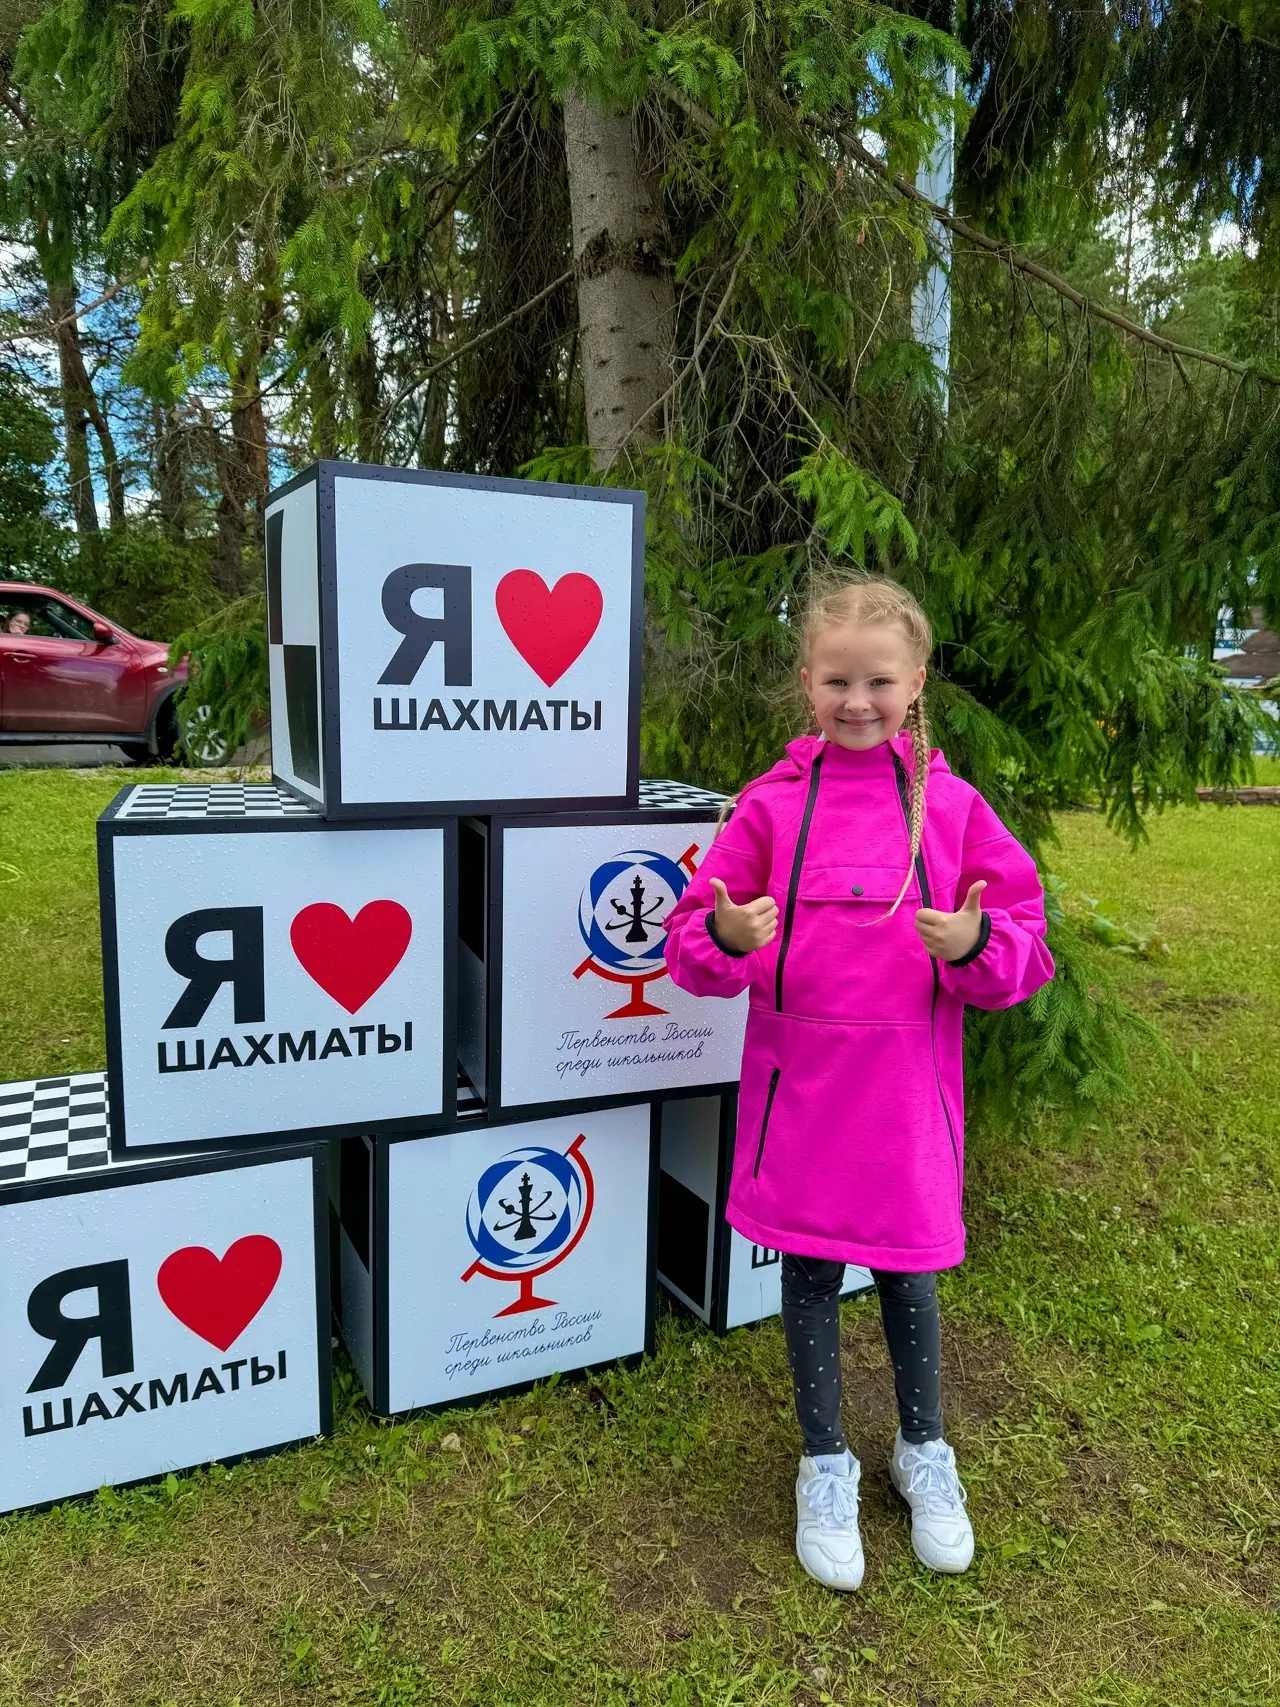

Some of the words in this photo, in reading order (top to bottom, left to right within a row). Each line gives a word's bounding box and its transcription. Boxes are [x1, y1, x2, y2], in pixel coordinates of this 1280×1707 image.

[377, 564, 472, 686] Я
[374, 698, 601, 730] ШАХМАТЫ
[161, 906, 265, 1029] Я
[158, 1022, 413, 1074] ШАХМАТЫ
[556, 1026, 656, 1057] Первенство
[661, 1022, 715, 1041] России
[556, 1057, 602, 1080] среди
[607, 1041, 705, 1068] школьников
[26, 1259, 134, 1394] Я
[444, 1356, 492, 1381] среди
[497, 1325, 594, 1363] школьников
[445, 1319, 546, 1357] Первенство
[551, 1310, 603, 1331] России
[23, 1350, 287, 1438] ШАХМАТЫ
